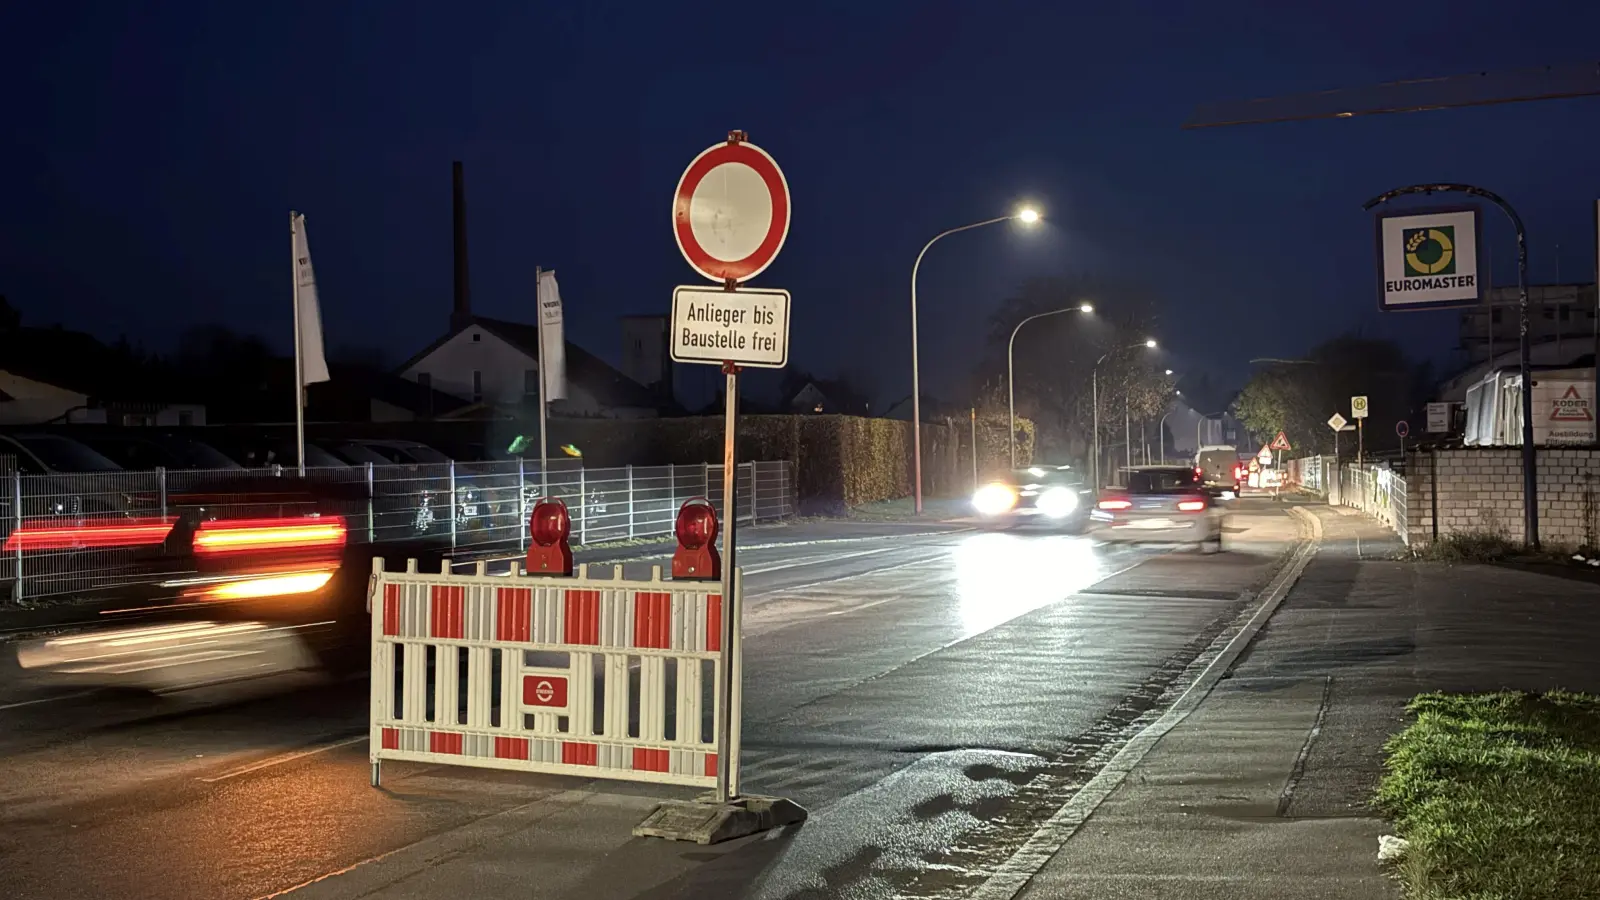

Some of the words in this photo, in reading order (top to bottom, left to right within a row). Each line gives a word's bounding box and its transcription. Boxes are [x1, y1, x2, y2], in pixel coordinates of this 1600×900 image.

[1386, 275, 1475, 293] EUROMASTER
[687, 302, 746, 328] Anlieger
[753, 305, 774, 325] bis
[682, 327, 746, 350] Baustelle
[752, 331, 776, 352] frei
[1548, 430, 1594, 439] Ausbildung
